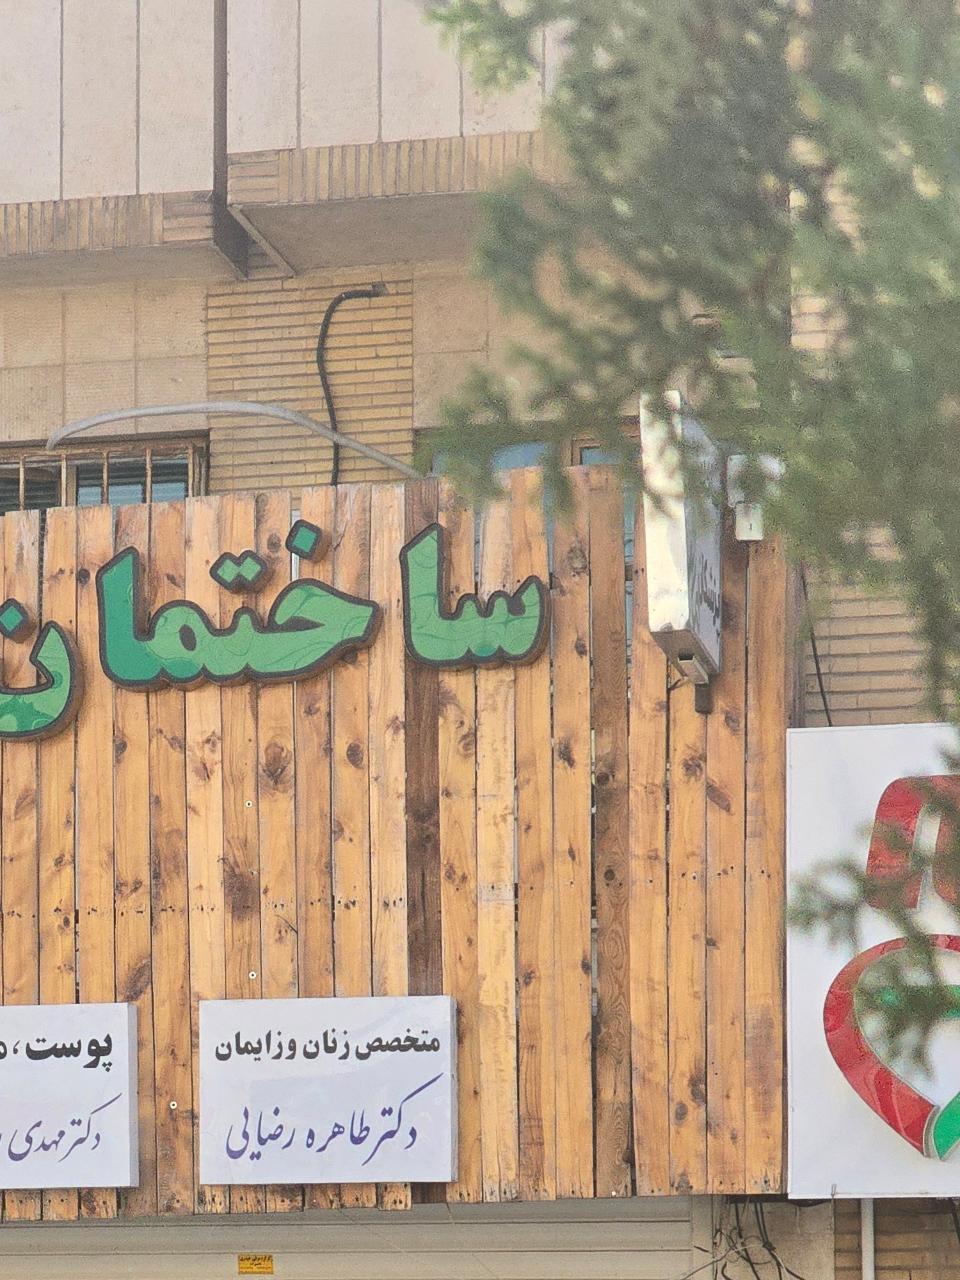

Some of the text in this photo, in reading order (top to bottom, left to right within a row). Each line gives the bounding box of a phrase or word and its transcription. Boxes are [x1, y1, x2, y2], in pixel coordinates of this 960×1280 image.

[215, 1029, 284, 1062] زایمان
[302, 1028, 350, 1061] زنان
[355, 1028, 441, 1061] متخصص
[58, 1092, 123, 1163] دکتر
[305, 1110, 371, 1153] طاهره
[361, 1072, 444, 1166] دکتر
[7, 1120, 66, 1162] مهدی
